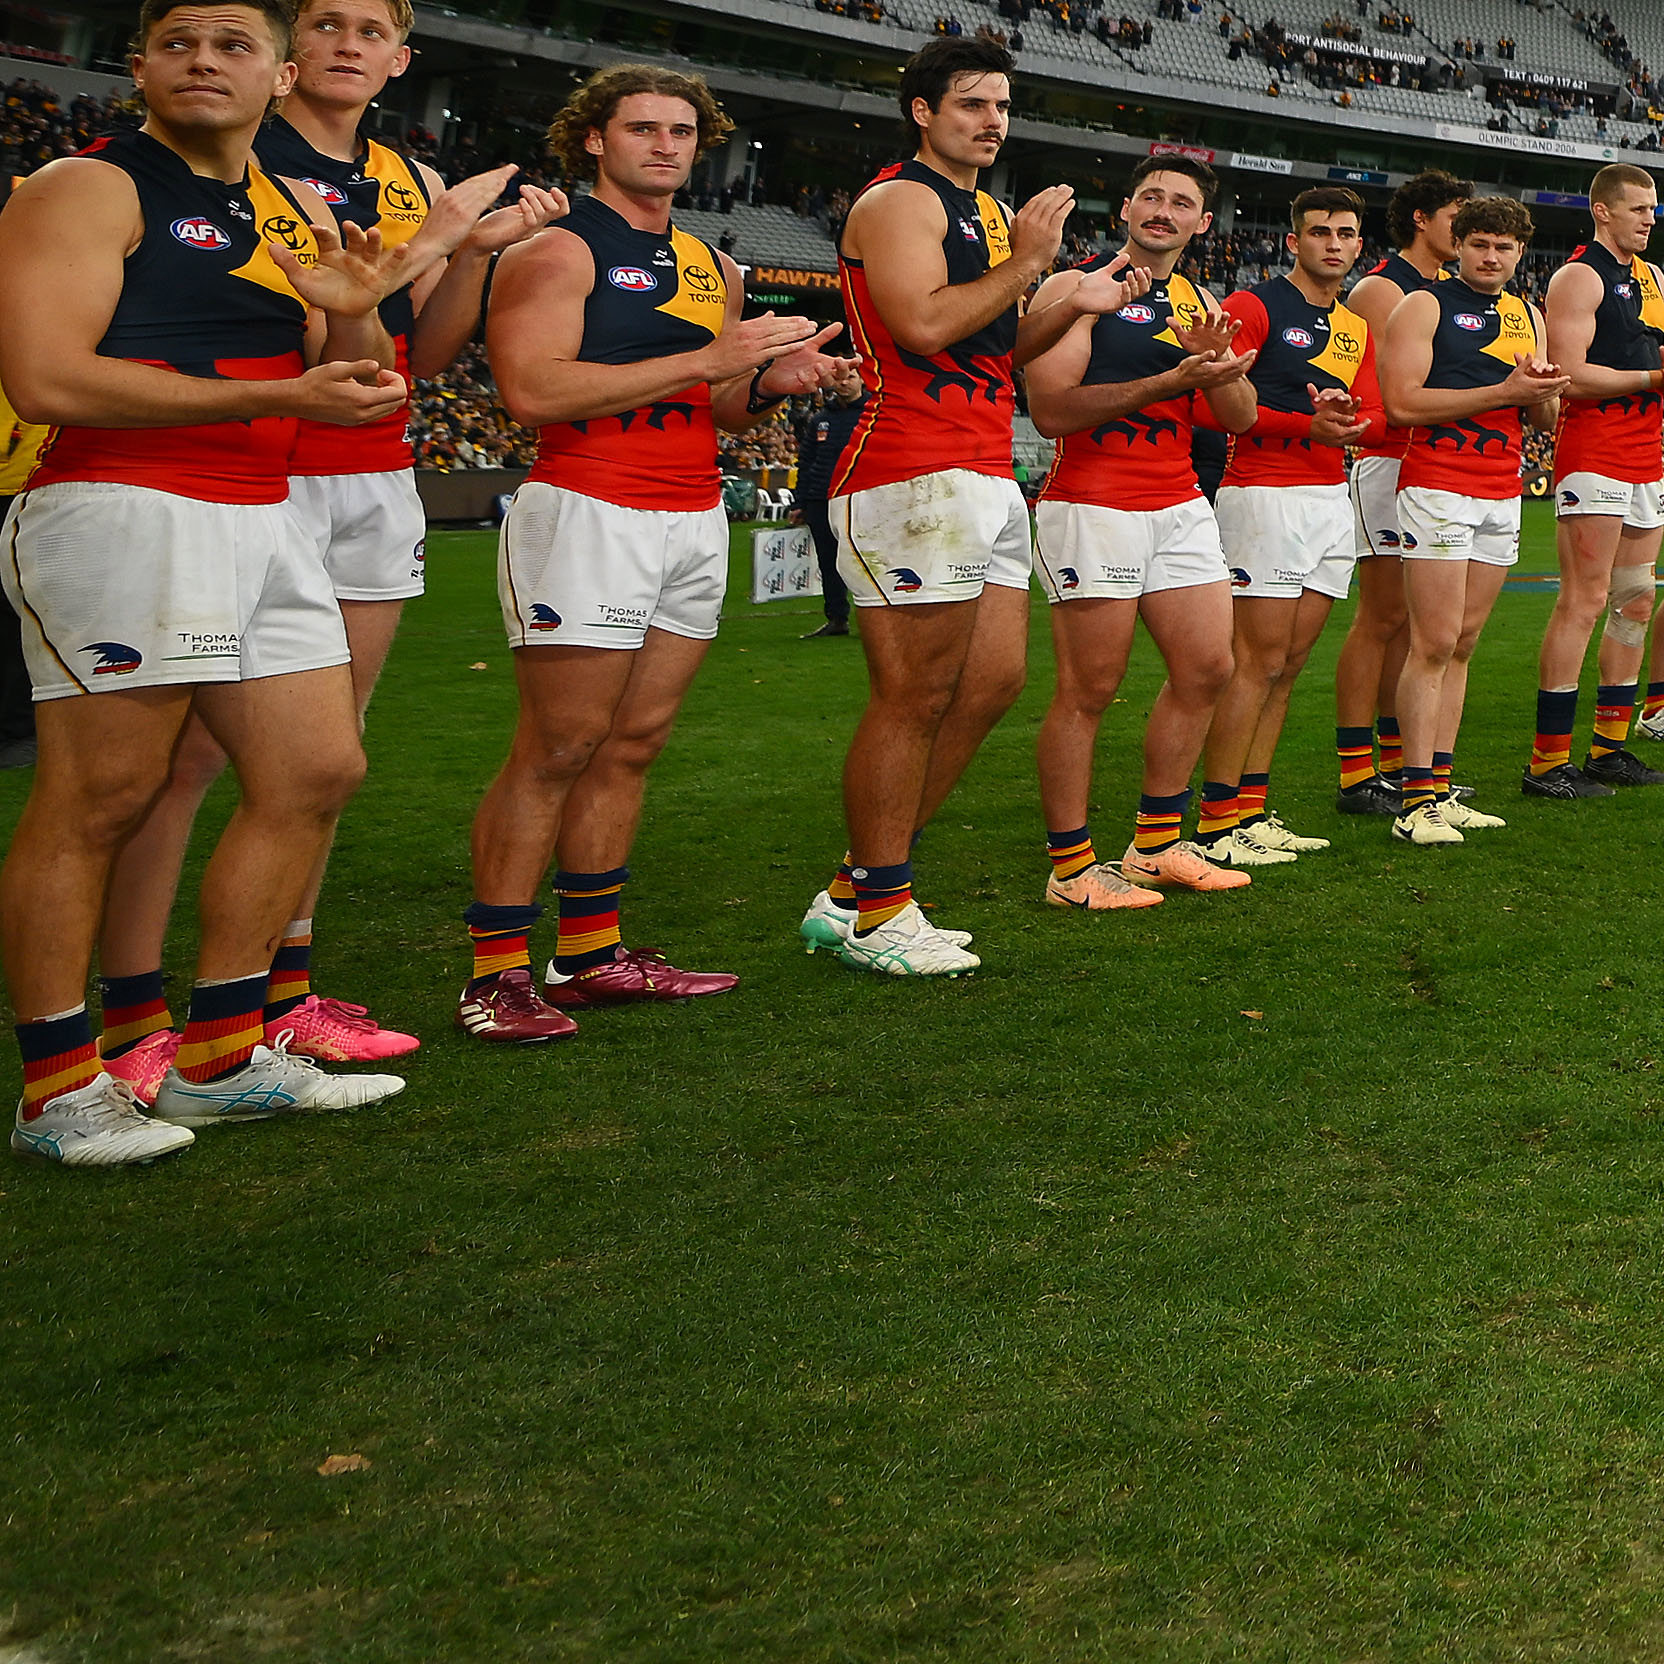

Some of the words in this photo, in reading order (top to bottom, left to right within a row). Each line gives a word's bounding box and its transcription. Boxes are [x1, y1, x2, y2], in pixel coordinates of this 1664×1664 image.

[1313, 37, 1371, 57] ANTISOCIAL
[1373, 47, 1427, 66] BEHAVIOUR
[1557, 77, 1571, 87] 117
[1572, 80, 1588, 91] 621
[1478, 132, 1520, 149] OLYMPIC
[1520, 136, 1553, 152] STAND
[1555, 142, 1577, 154] 2006
[1238, 156, 1266, 171] Herald
[1268, 159, 1287, 172] Sun
[179, 223, 229, 243] AFL
[613, 270, 655, 287] AFL
[756, 267, 841, 288] HAWTH
[1458, 315, 1483, 328] AFL
[1285, 330, 1312, 345] AFL
[1504, 331, 1531, 340] TOYOTA
[1332, 352, 1360, 364] TOYOTA
[1101, 565, 1141, 574] THOMAS
[598, 605, 648, 618] THOMAS
